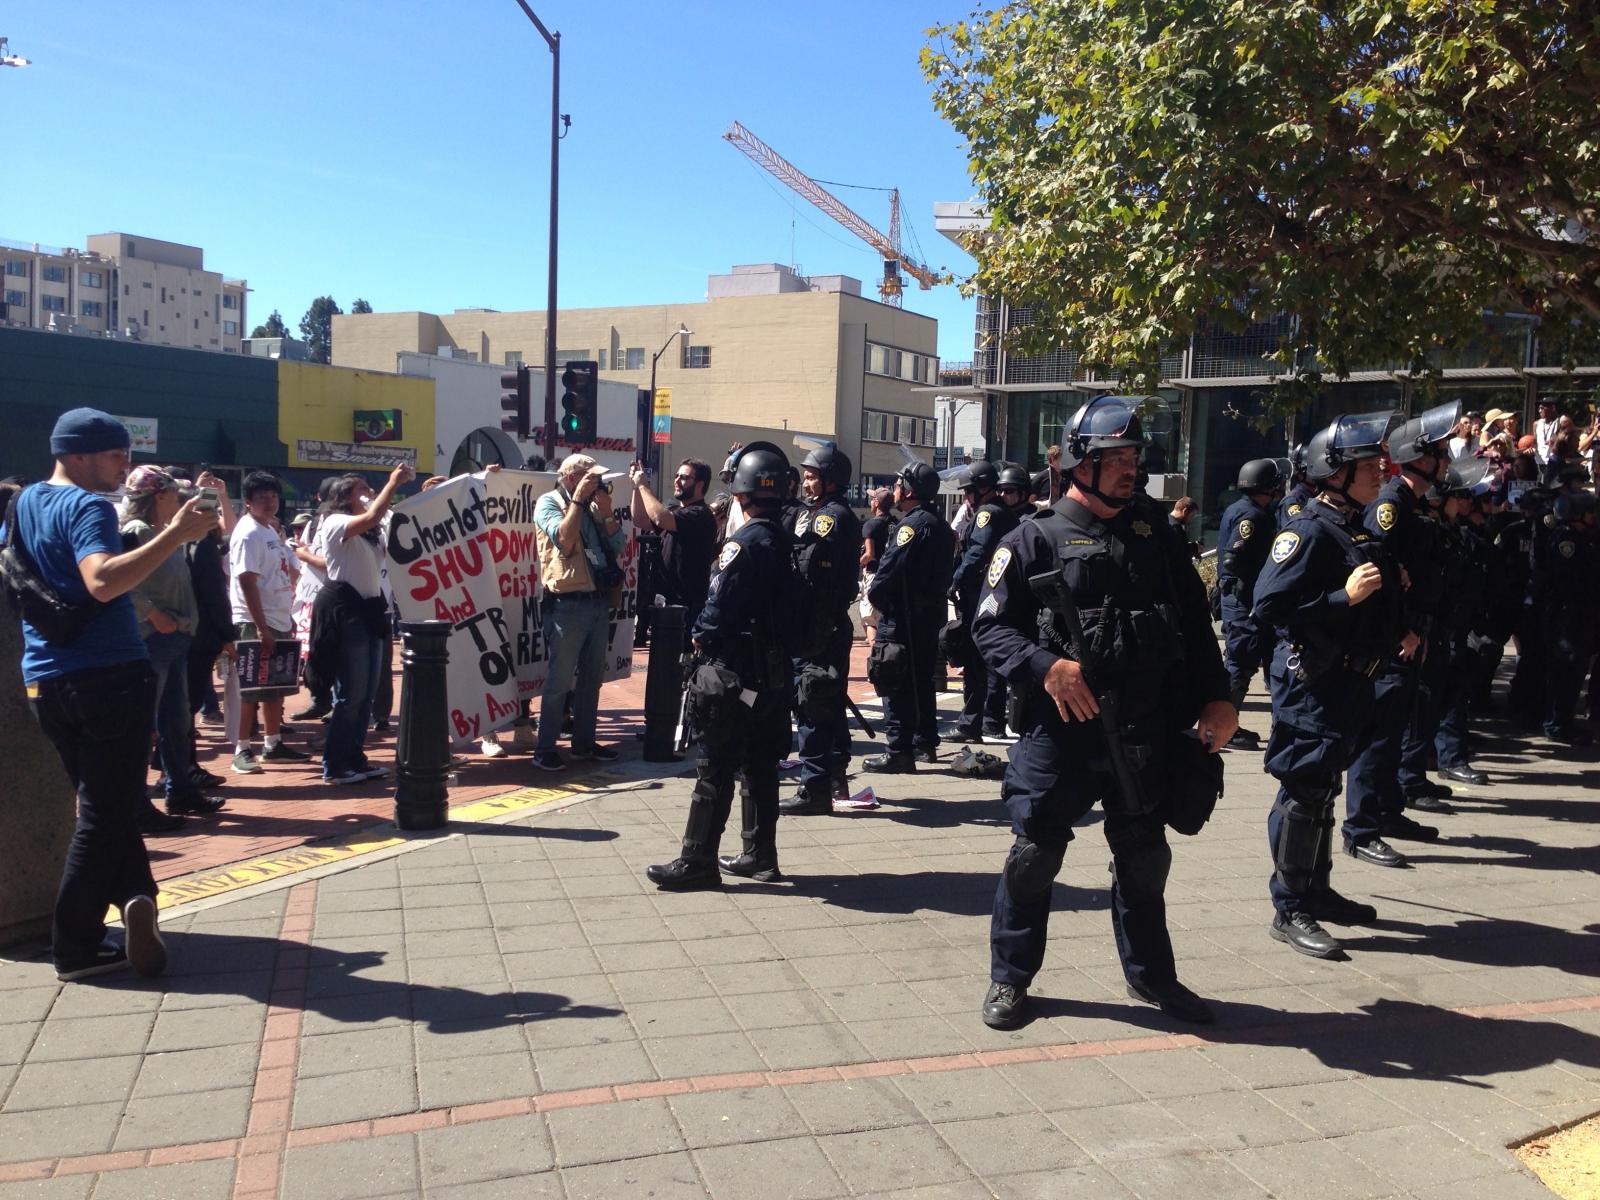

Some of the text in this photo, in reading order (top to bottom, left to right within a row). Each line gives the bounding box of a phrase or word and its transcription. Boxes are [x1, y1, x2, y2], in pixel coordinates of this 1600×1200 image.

[434, 586, 478, 625] And
[450, 709, 481, 738] By
[485, 693, 521, 723] Any
[159, 850, 328, 900] WALK ZONE
